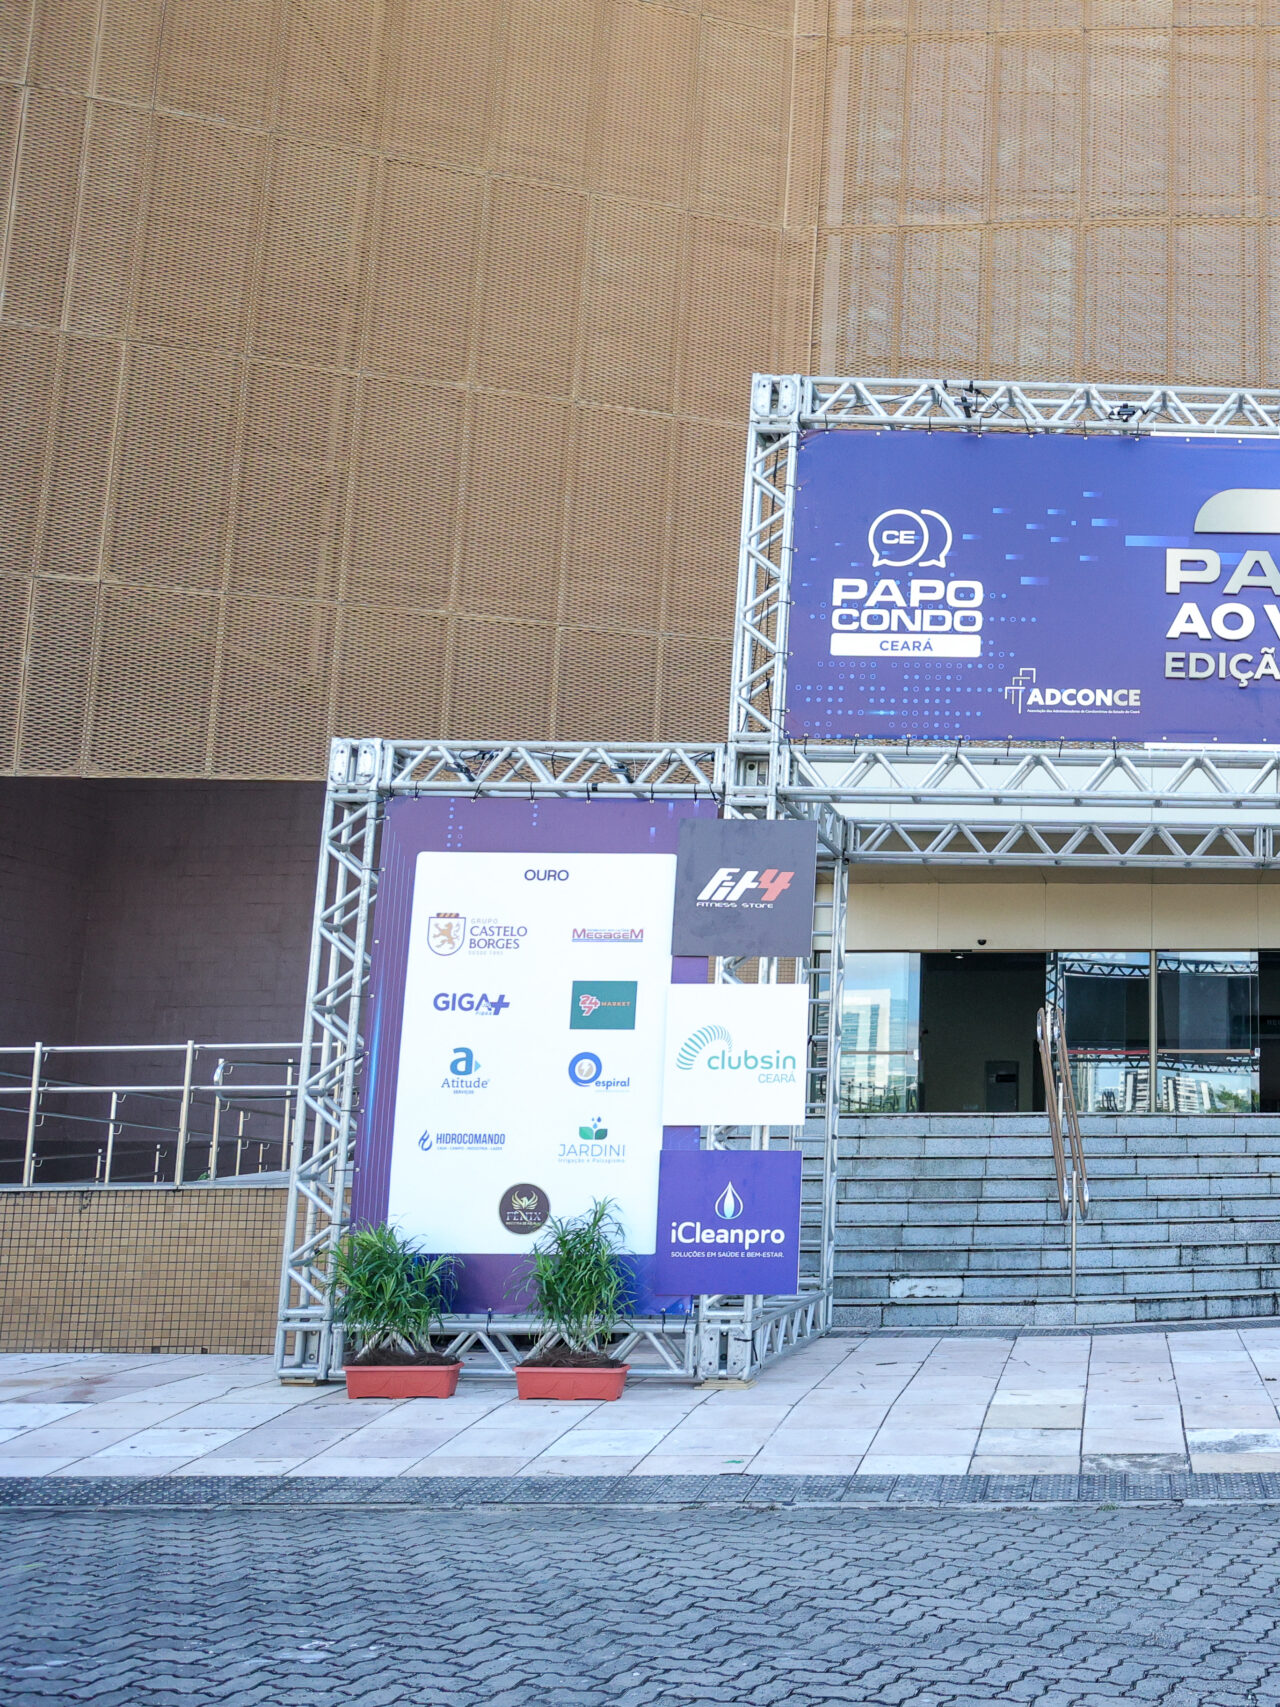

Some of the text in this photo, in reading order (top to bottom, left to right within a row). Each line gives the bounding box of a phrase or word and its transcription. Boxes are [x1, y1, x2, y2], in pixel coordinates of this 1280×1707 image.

[881, 530, 916, 544] CE
[831, 578, 984, 608] PAPO
[831, 608, 984, 632] CONDO
[1165, 602, 1256, 642] AO
[879, 637, 934, 652] CEARÁ
[1026, 688, 1141, 706] ADCONCE
[524, 869, 569, 882] OURO
[469, 925, 528, 937] CASTELO
[469, 938, 520, 950] BORGES
[707, 1049, 796, 1070] clubsin
[441, 1077, 489, 1089] Atitude
[594, 1076, 630, 1090] espiral
[758, 1070, 796, 1083] CEARÁ
[436, 1132, 506, 1145] HIDROCOMANDO
[557, 1144, 626, 1157] JARDINI
[505, 1210, 542, 1221] FÊNIX
[670, 1222, 785, 1250] iCleanpro
[671, 1250, 706, 1259] SOLUÇÕES
[717, 1250, 739, 1258] SAÚDE
